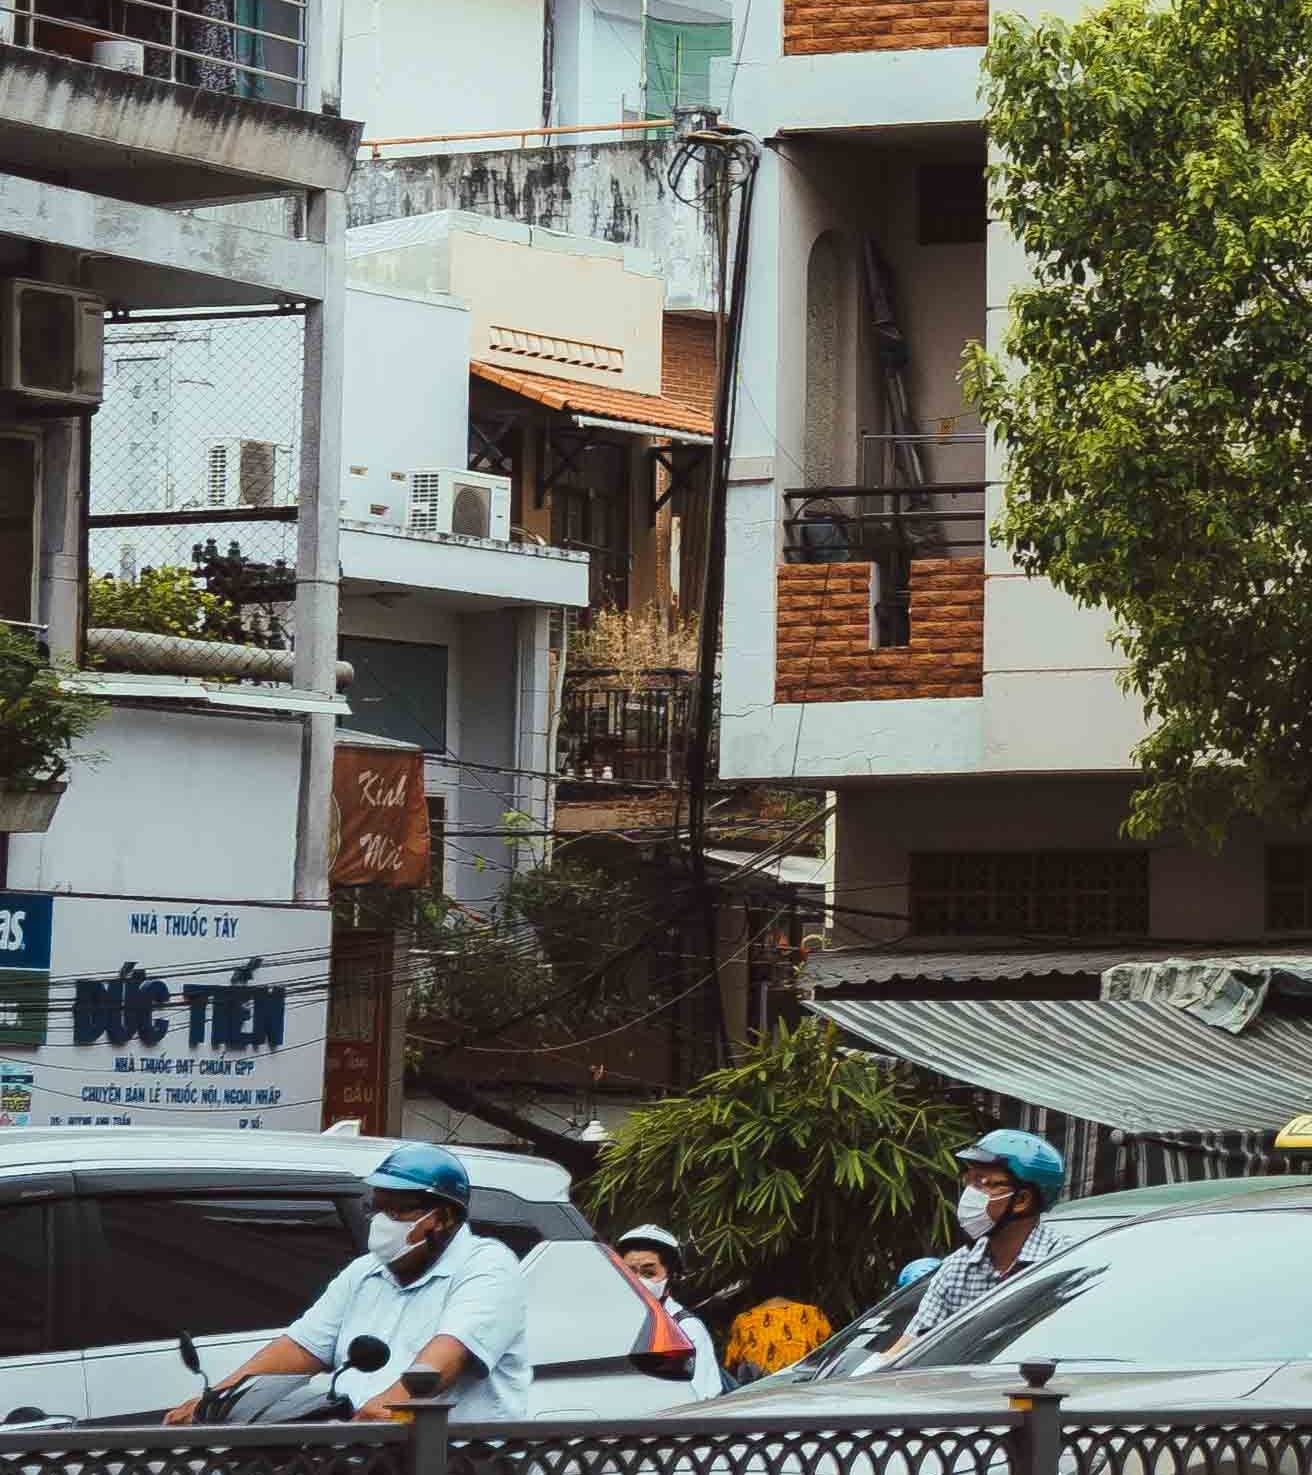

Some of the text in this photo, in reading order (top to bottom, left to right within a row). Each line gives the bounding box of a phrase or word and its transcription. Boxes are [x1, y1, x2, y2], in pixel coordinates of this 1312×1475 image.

[130, 906, 240, 938] NHÀ THUỐC TÂY
[114, 1053, 136, 1073] NHÀ
[140, 1051, 174, 1074] THUỐC
[234, 1061, 256, 1076] GPP
[165, 1081, 198, 1104] THUỐC
